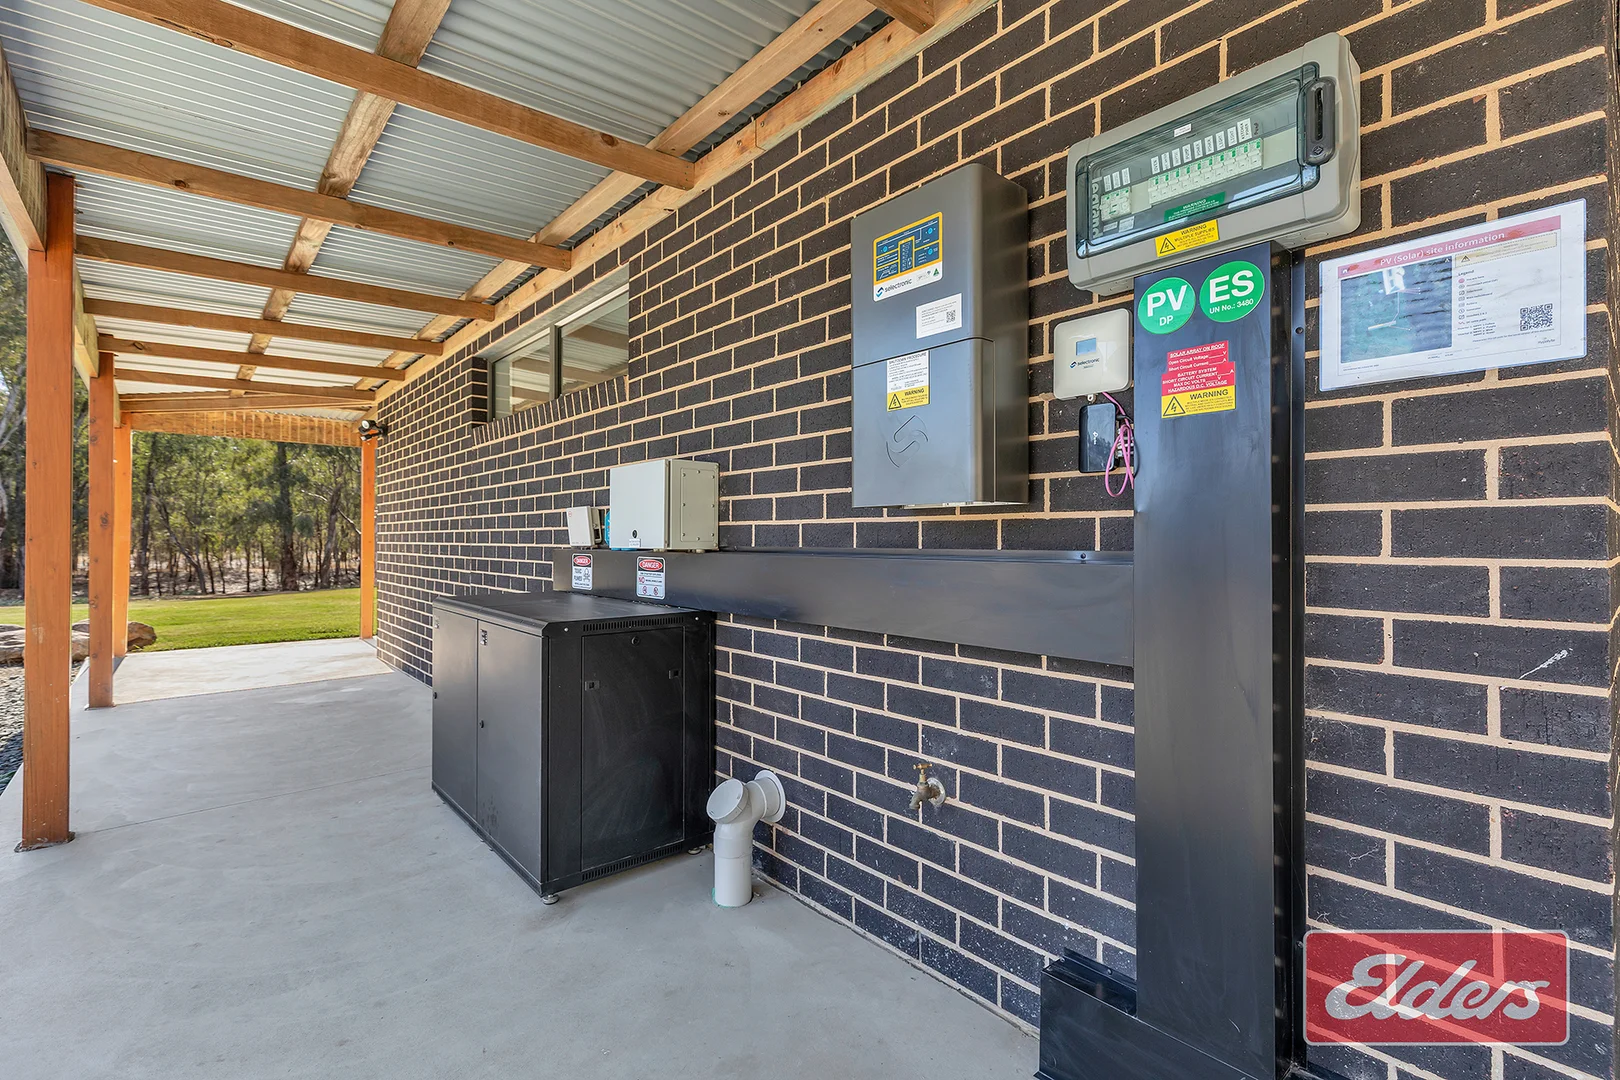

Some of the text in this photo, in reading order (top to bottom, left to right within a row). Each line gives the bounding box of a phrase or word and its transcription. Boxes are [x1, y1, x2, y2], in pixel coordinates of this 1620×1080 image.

[1091, 176, 1104, 239] legrand
[1182, 199, 1207, 209] WARNING
[1174, 233, 1194, 242] MULTIPLE
[1195, 227, 1215, 236] SUPPLIES
[1180, 223, 1207, 235] WARNING
[1380, 257, 1393, 266] PV
[1393, 250, 1424, 264] (Solar)
[1426, 245, 1443, 255] site
[1445, 232, 1505, 251] information
[884, 278, 912, 293] selectronic
[1209, 270, 1255, 304] ES
[1147, 284, 1188, 317] PV
[1209, 306, 1220, 314] UN
[1236, 298, 1254, 308] 3480
[1159, 315, 1174, 326] DP
[1170, 350, 1185, 358] SOLAR
[1185, 347, 1202, 356] ARRAY
[1211, 343, 1225, 351] ROOF
[1077, 358, 1100, 366] selectronic
[1177, 370, 1198, 378] BATTERY
[904, 387, 925, 396] WARNING
[1167, 385, 1195, 393] HAZARDOUS
[1189, 388, 1229, 400] WARNING
[642, 561, 660, 569] DANGER
